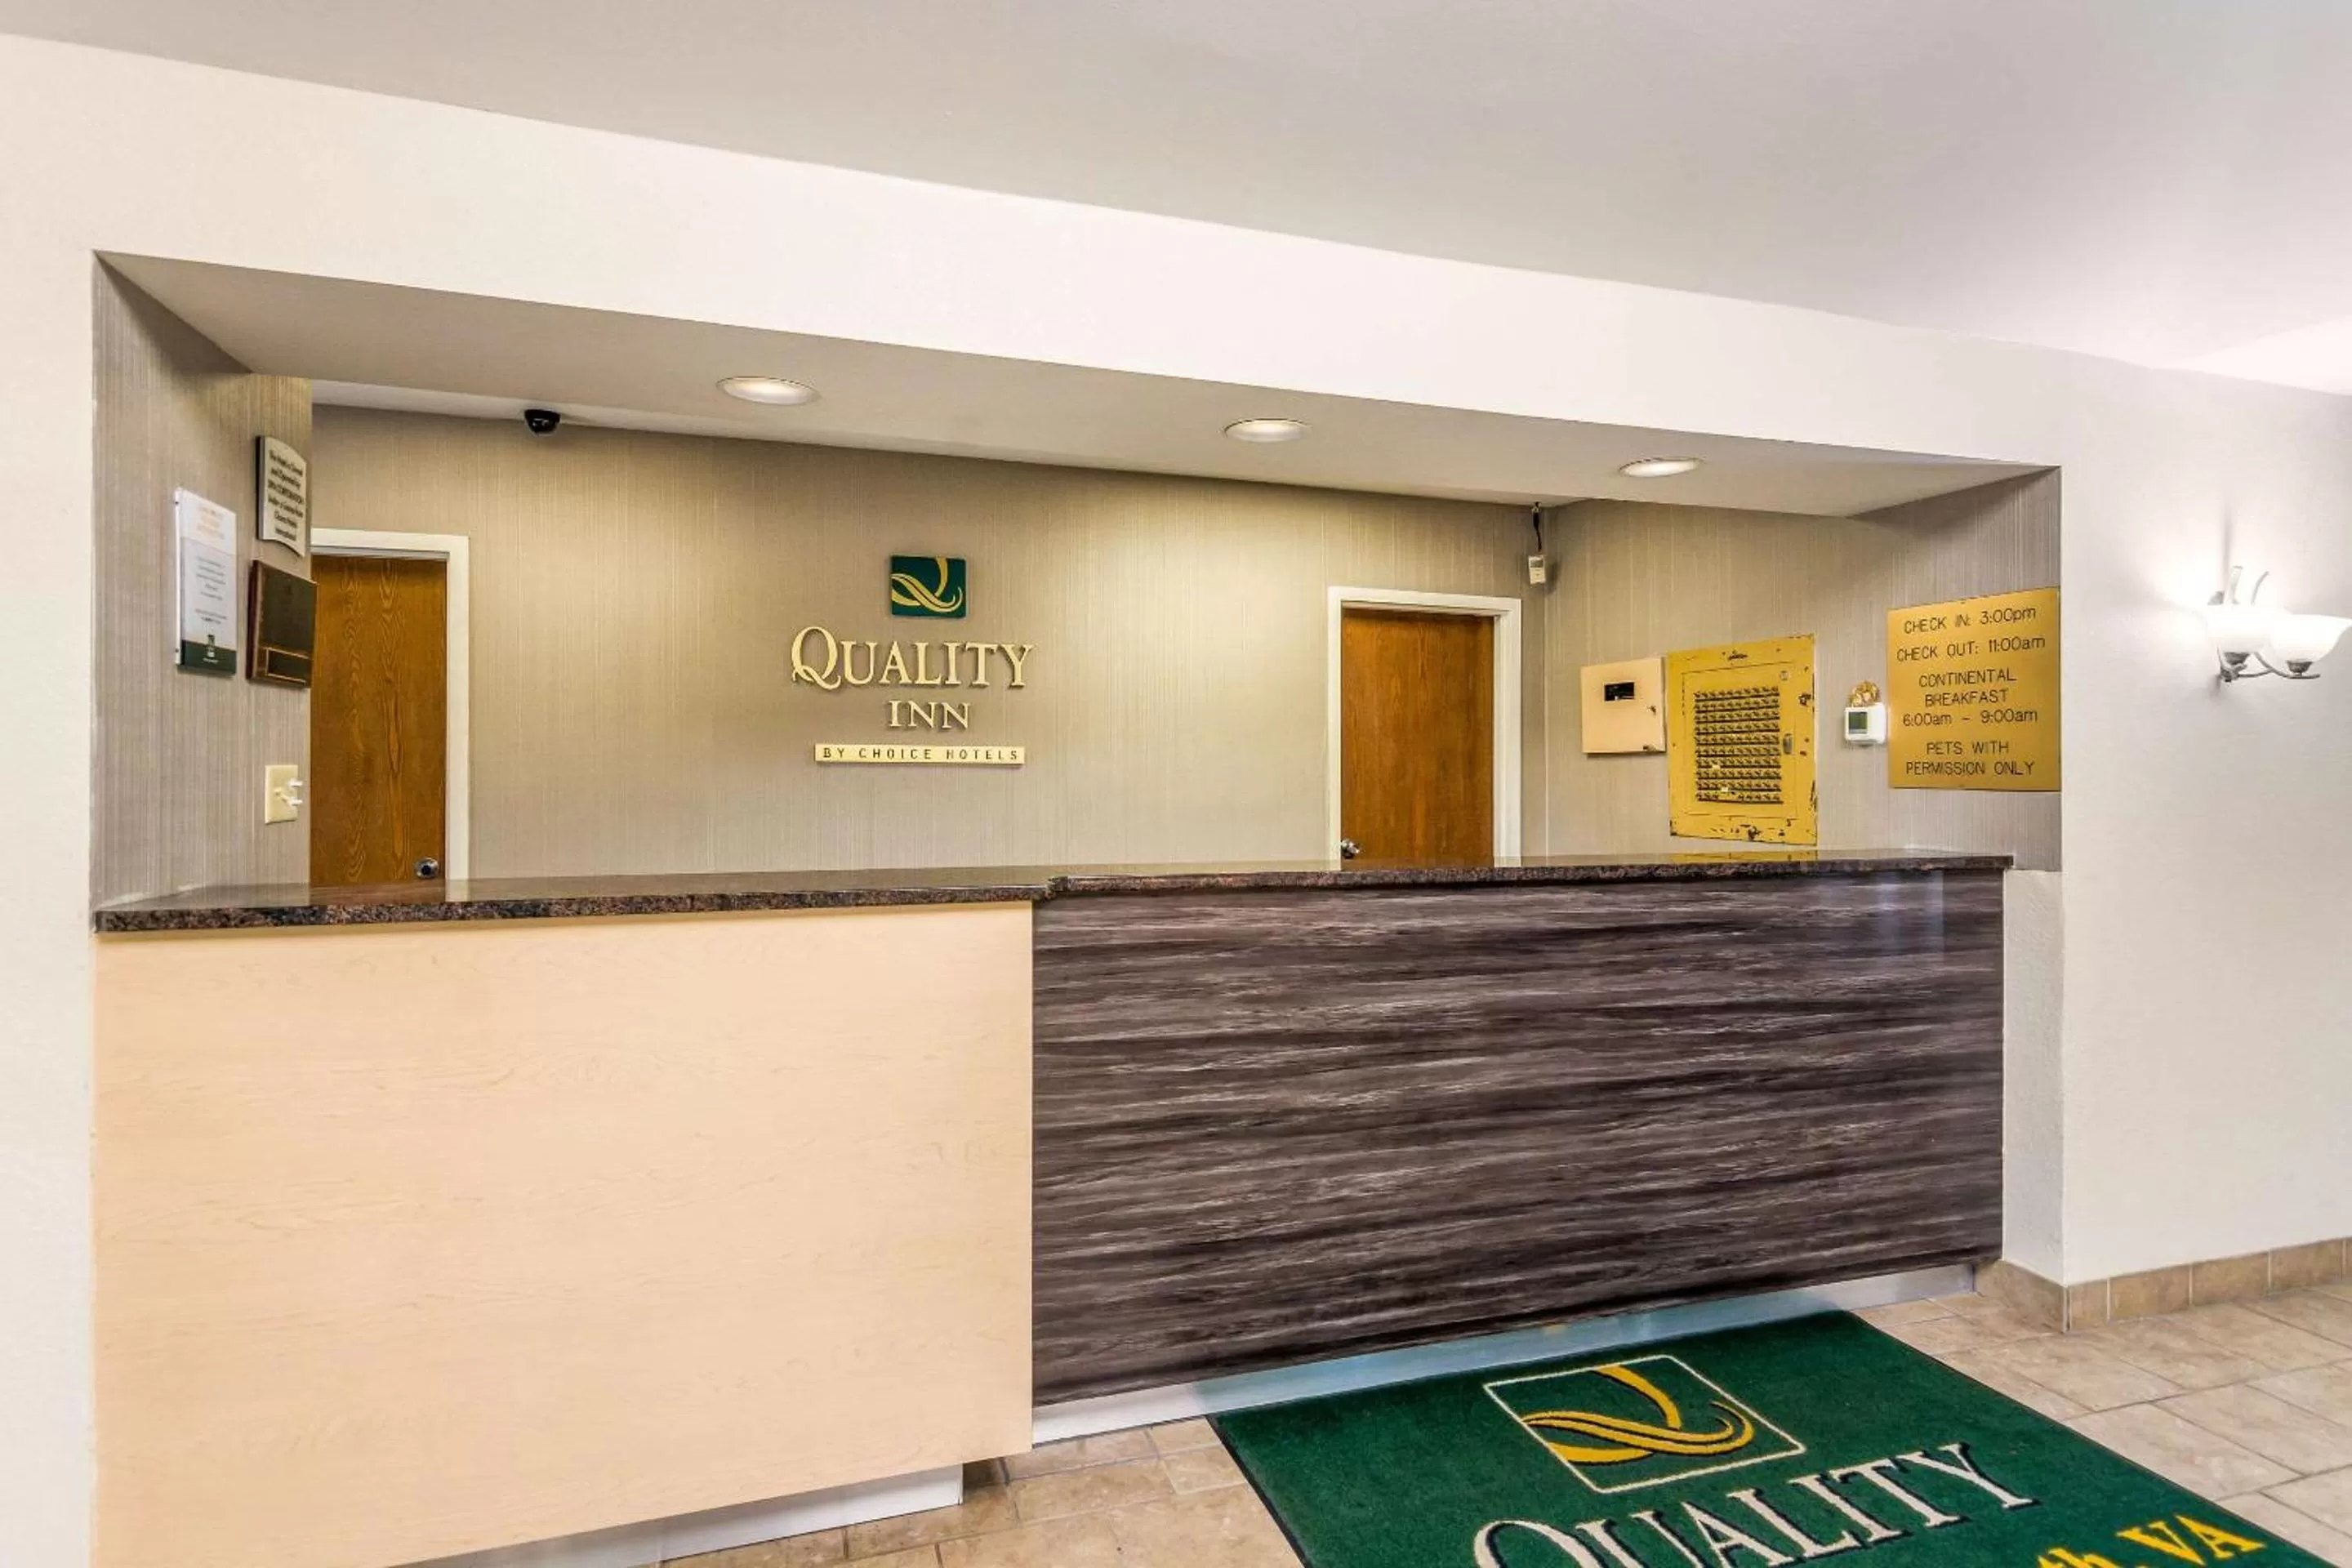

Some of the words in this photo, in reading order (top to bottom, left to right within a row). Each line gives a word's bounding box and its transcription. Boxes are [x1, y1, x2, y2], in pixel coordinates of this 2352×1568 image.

[1904, 616, 1946, 634] CHECK
[1980, 607, 2036, 626] 3:00pm
[791, 626, 1034, 691] QUALITY
[1896, 644, 1939, 662] CHECK
[1946, 640, 1980, 657] OUT:
[1989, 636, 2046, 653] 11:00am
[1918, 666, 2016, 688] CONTINENTAL
[1925, 688, 2009, 706] BREAKFAST
[889, 699, 970, 729] INN
[1903, 712, 1952, 727] 6:00am
[1980, 709, 2038, 725] 9:00am
[822, 746, 845, 759] BY
[858, 747, 933, 760] CHOICE
[947, 749, 1018, 761] HOTELS
[1927, 741, 1963, 755] PETS
[1972, 740, 2009, 755] WITH
[1905, 761, 1984, 776] PERMISSION
[1993, 760, 2035, 776] ONLY
[2116, 1513, 2268, 1566] VA
